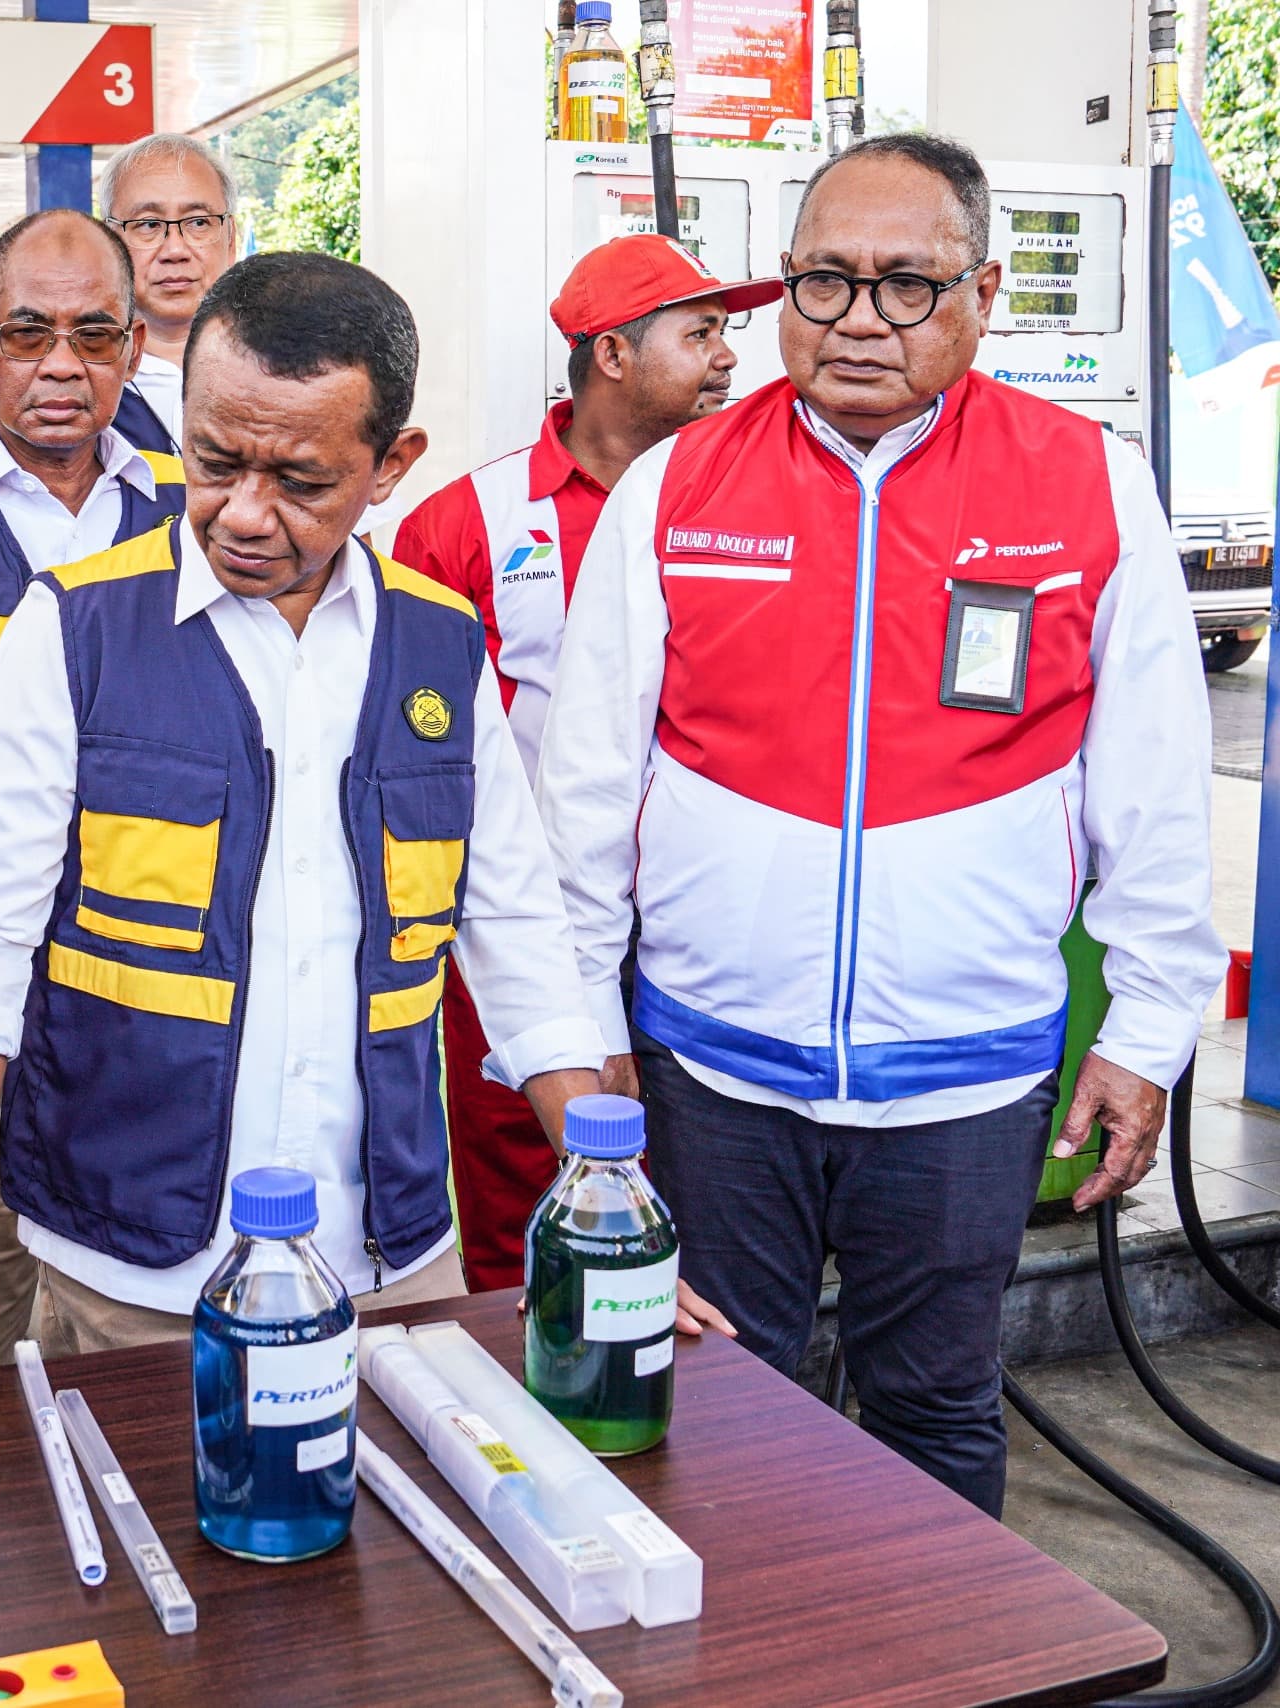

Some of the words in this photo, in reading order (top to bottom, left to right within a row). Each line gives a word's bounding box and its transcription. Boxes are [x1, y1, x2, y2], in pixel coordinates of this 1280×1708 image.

[768, 38, 785, 48] baik
[103, 63, 134, 106] 3
[569, 80, 625, 90] DEXLITE
[607, 189, 621, 199] Rp
[1000, 205, 1012, 215] Rp
[1017, 237, 1073, 247] JUMLAH
[1016, 278, 1072, 288] DIKELUARKAN
[998, 287, 1010, 296] Rp
[1016, 319, 1036, 329] HARGA
[1037, 320, 1052, 329] SATU
[1053, 320, 1071, 329] LITER
[993, 369, 1099, 383] PERTAMAX
[671, 531, 712, 548] EDUARD
[714, 533, 756, 554] ADOLOF
[995, 541, 1064, 557] PERTAMINA
[502, 570, 556, 584] PERTAMINA
